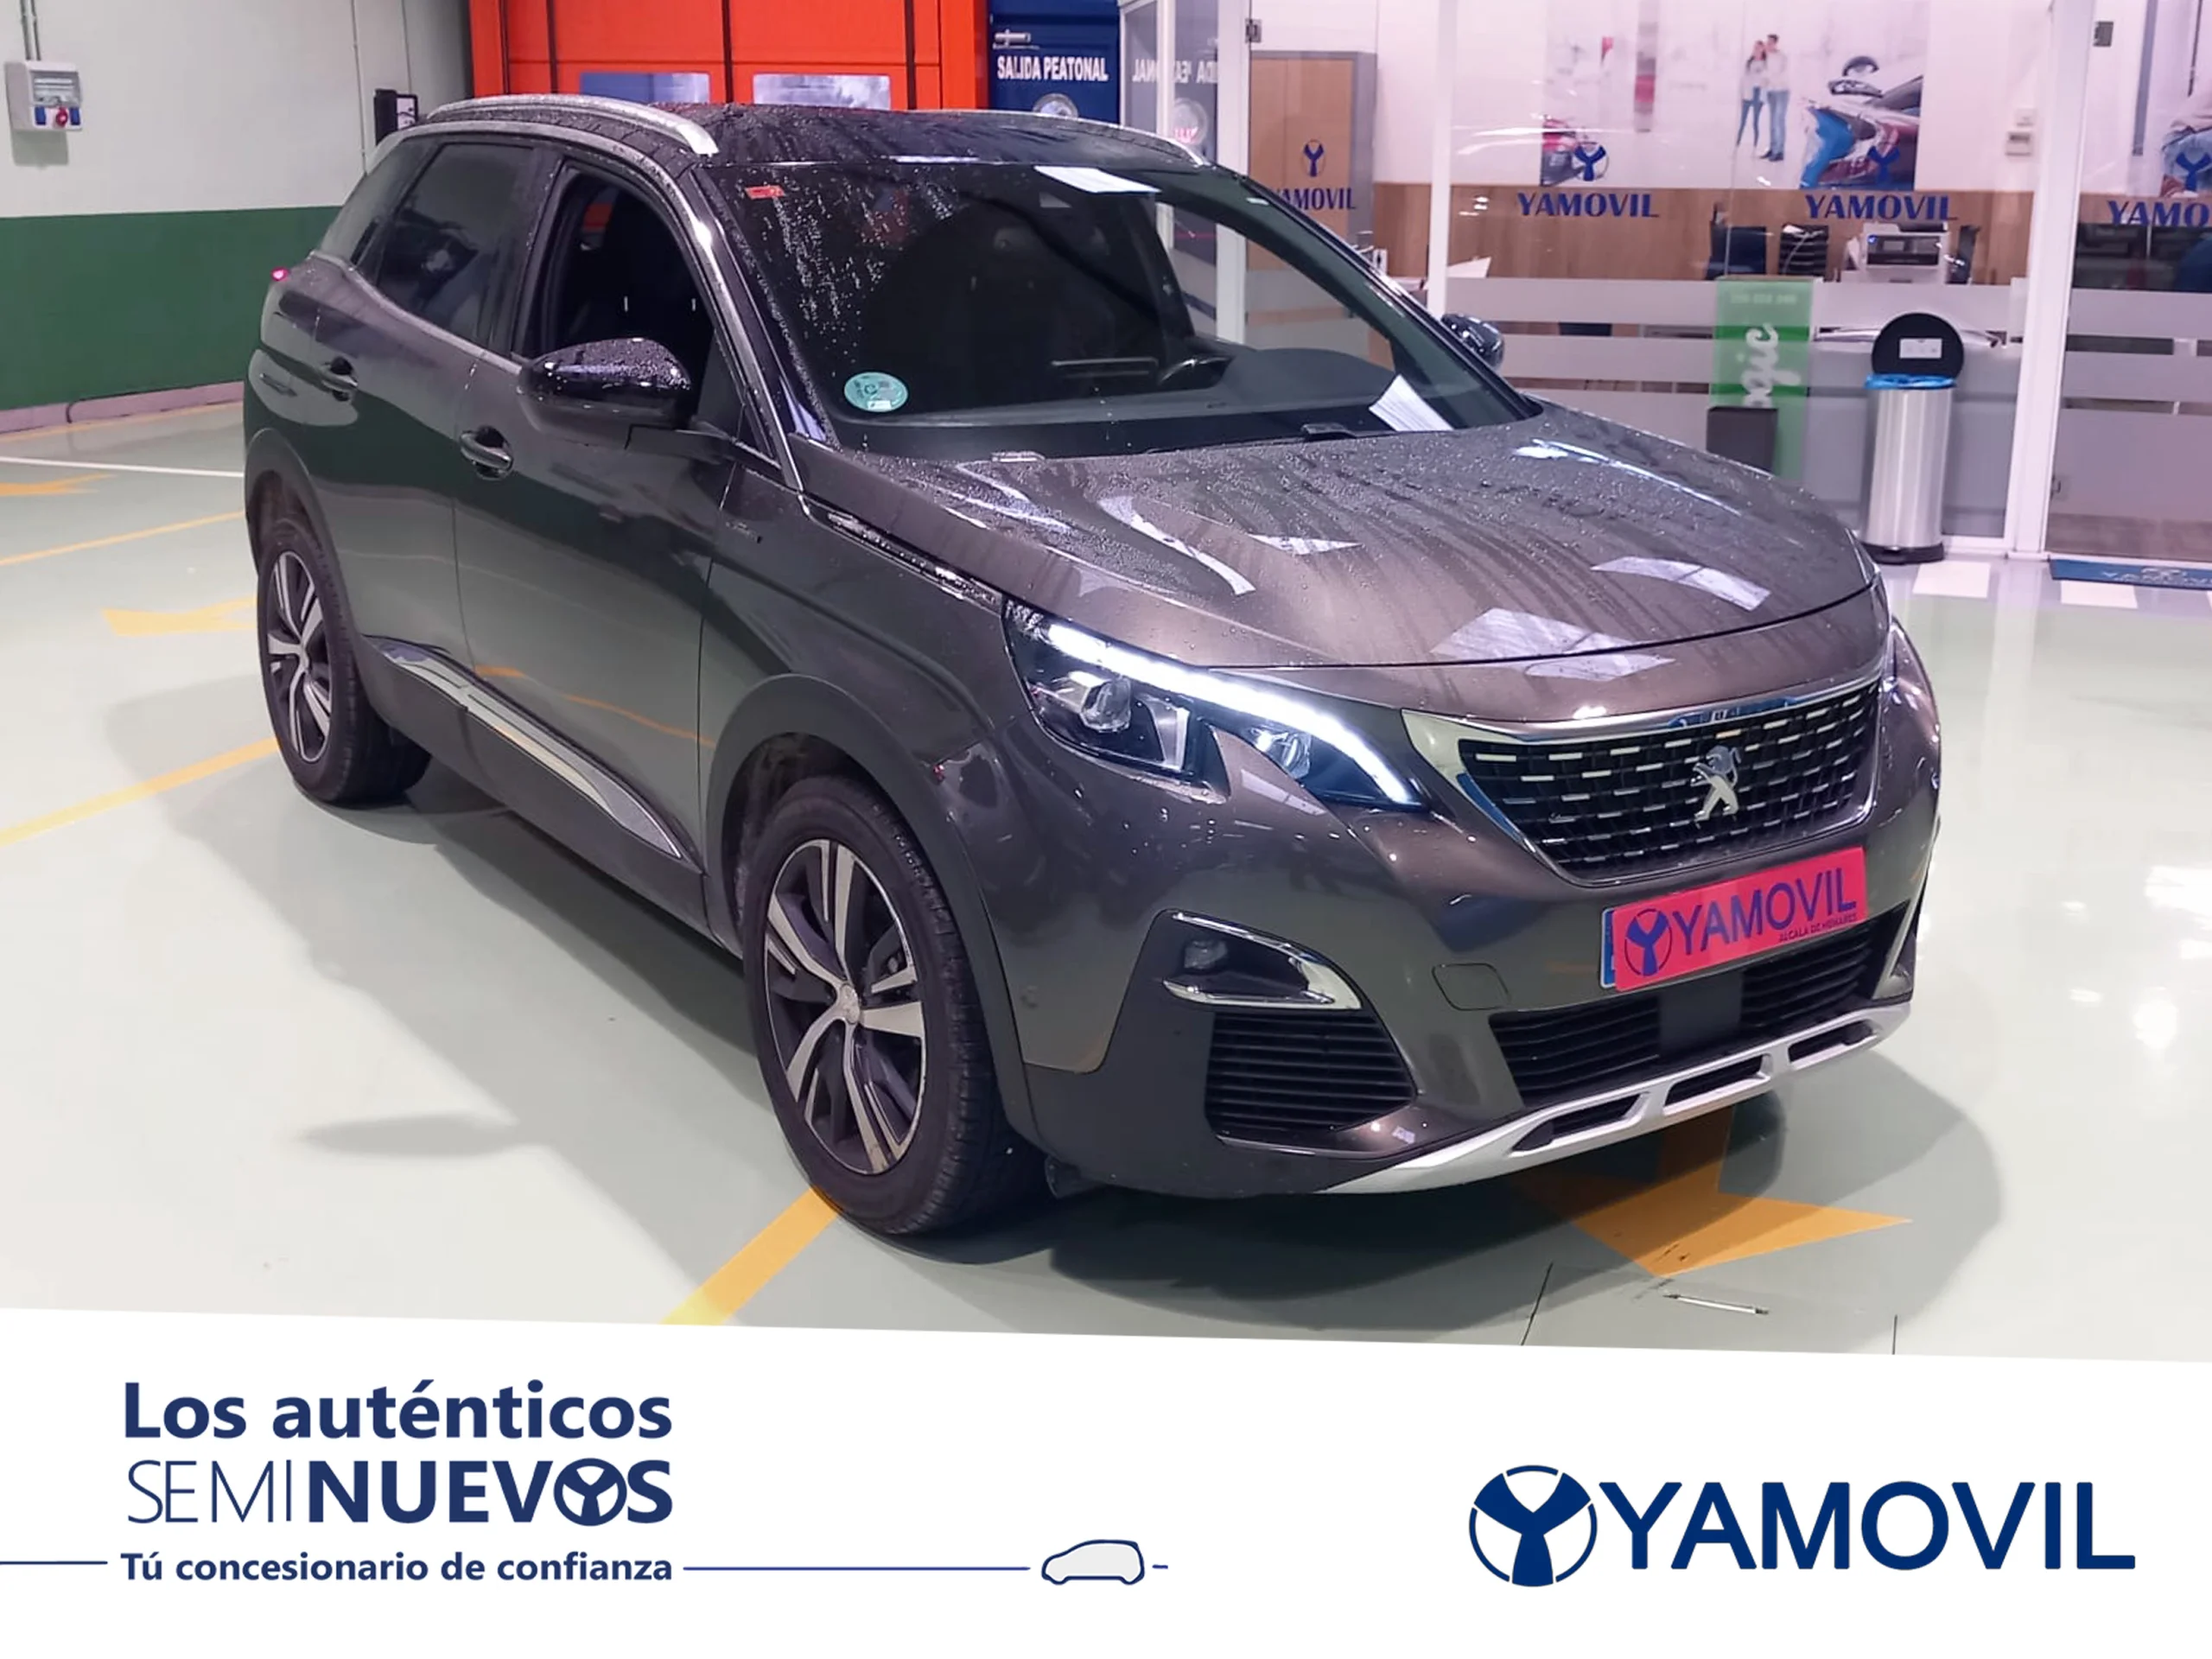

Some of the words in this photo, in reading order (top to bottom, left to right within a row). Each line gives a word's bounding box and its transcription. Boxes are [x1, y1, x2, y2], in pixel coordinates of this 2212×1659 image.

[997, 56, 1042, 80] SALIDA
[1043, 56, 1109, 82] PEATONAL
[1277, 188, 1357, 211] AMOVIL
[1517, 192, 1660, 218] YAMOVIL
[1805, 194, 1959, 220] YAMOVIL
[1672, 867, 1858, 956] YAMOVIL
